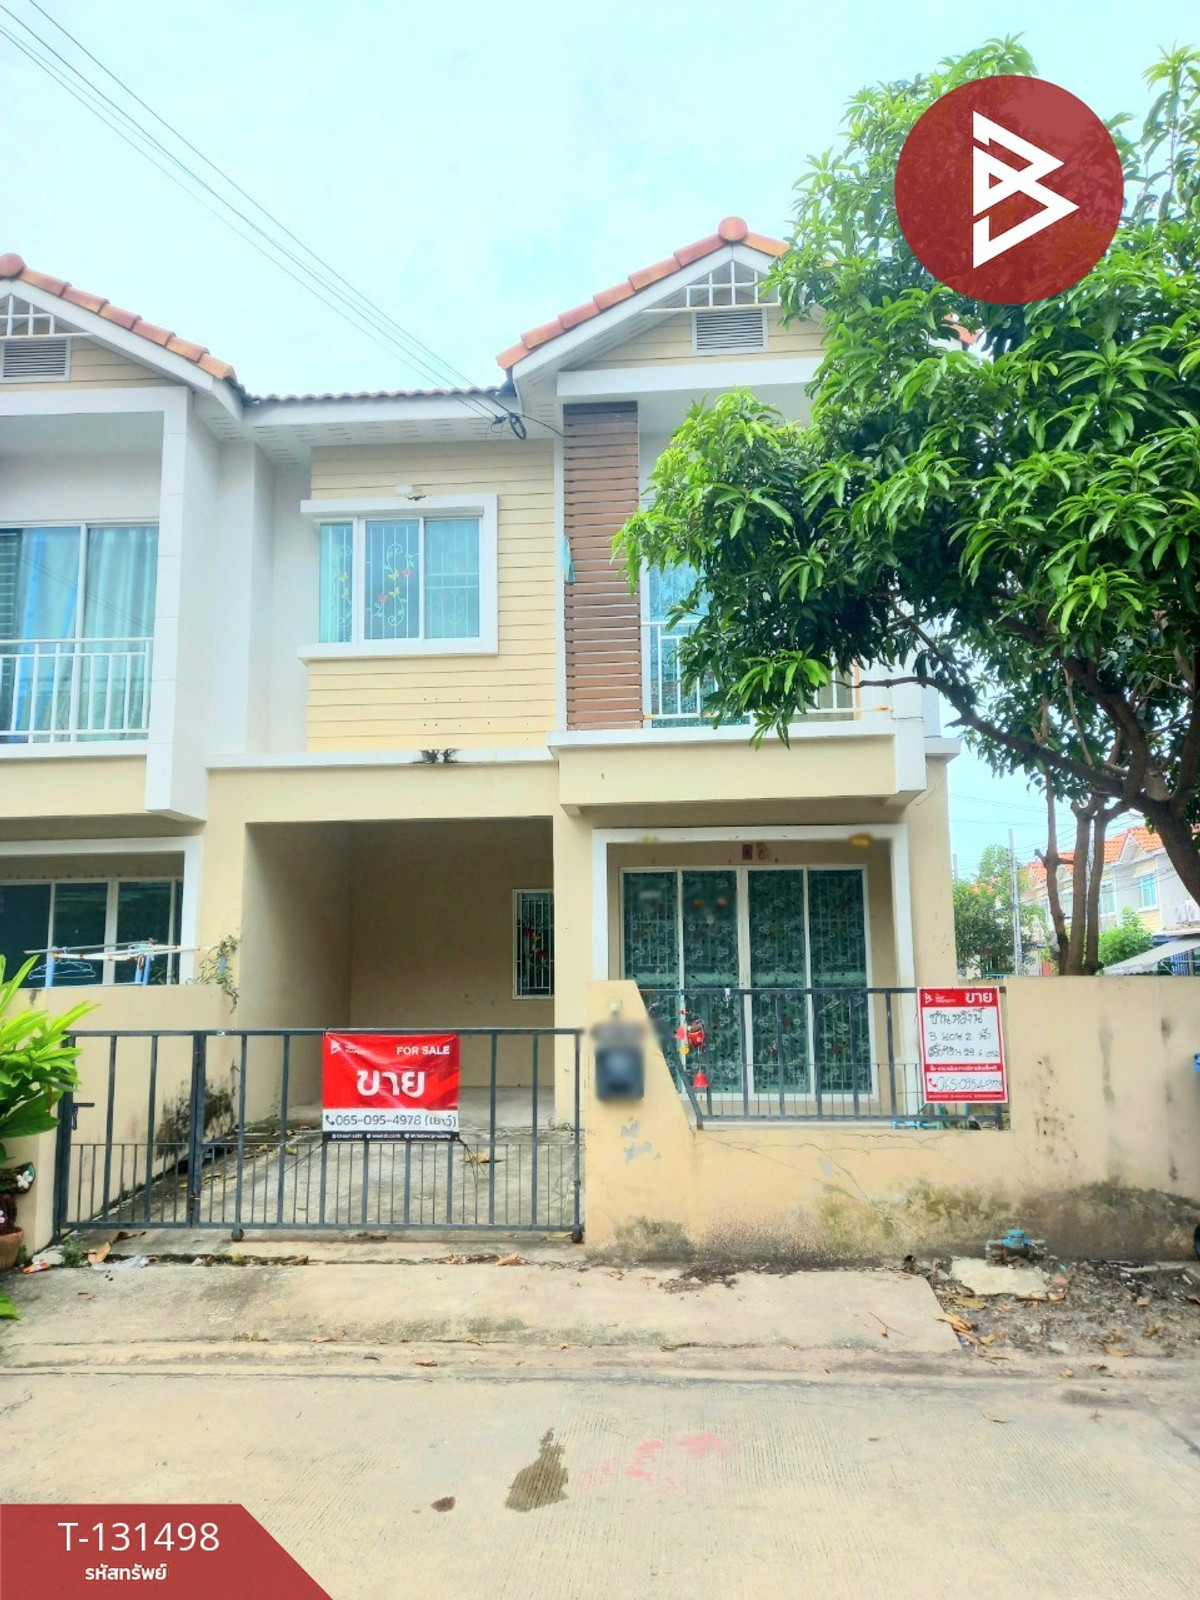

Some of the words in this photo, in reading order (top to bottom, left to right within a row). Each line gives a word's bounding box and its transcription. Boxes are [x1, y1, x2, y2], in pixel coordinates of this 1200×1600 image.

[965, 992, 993, 1003] ขาย
[396, 1046, 419, 1055] FOR
[421, 1045, 450, 1055] SALE
[357, 1070, 425, 1098] ขาย
[335, 1114, 422, 1126] 065-095-4978
